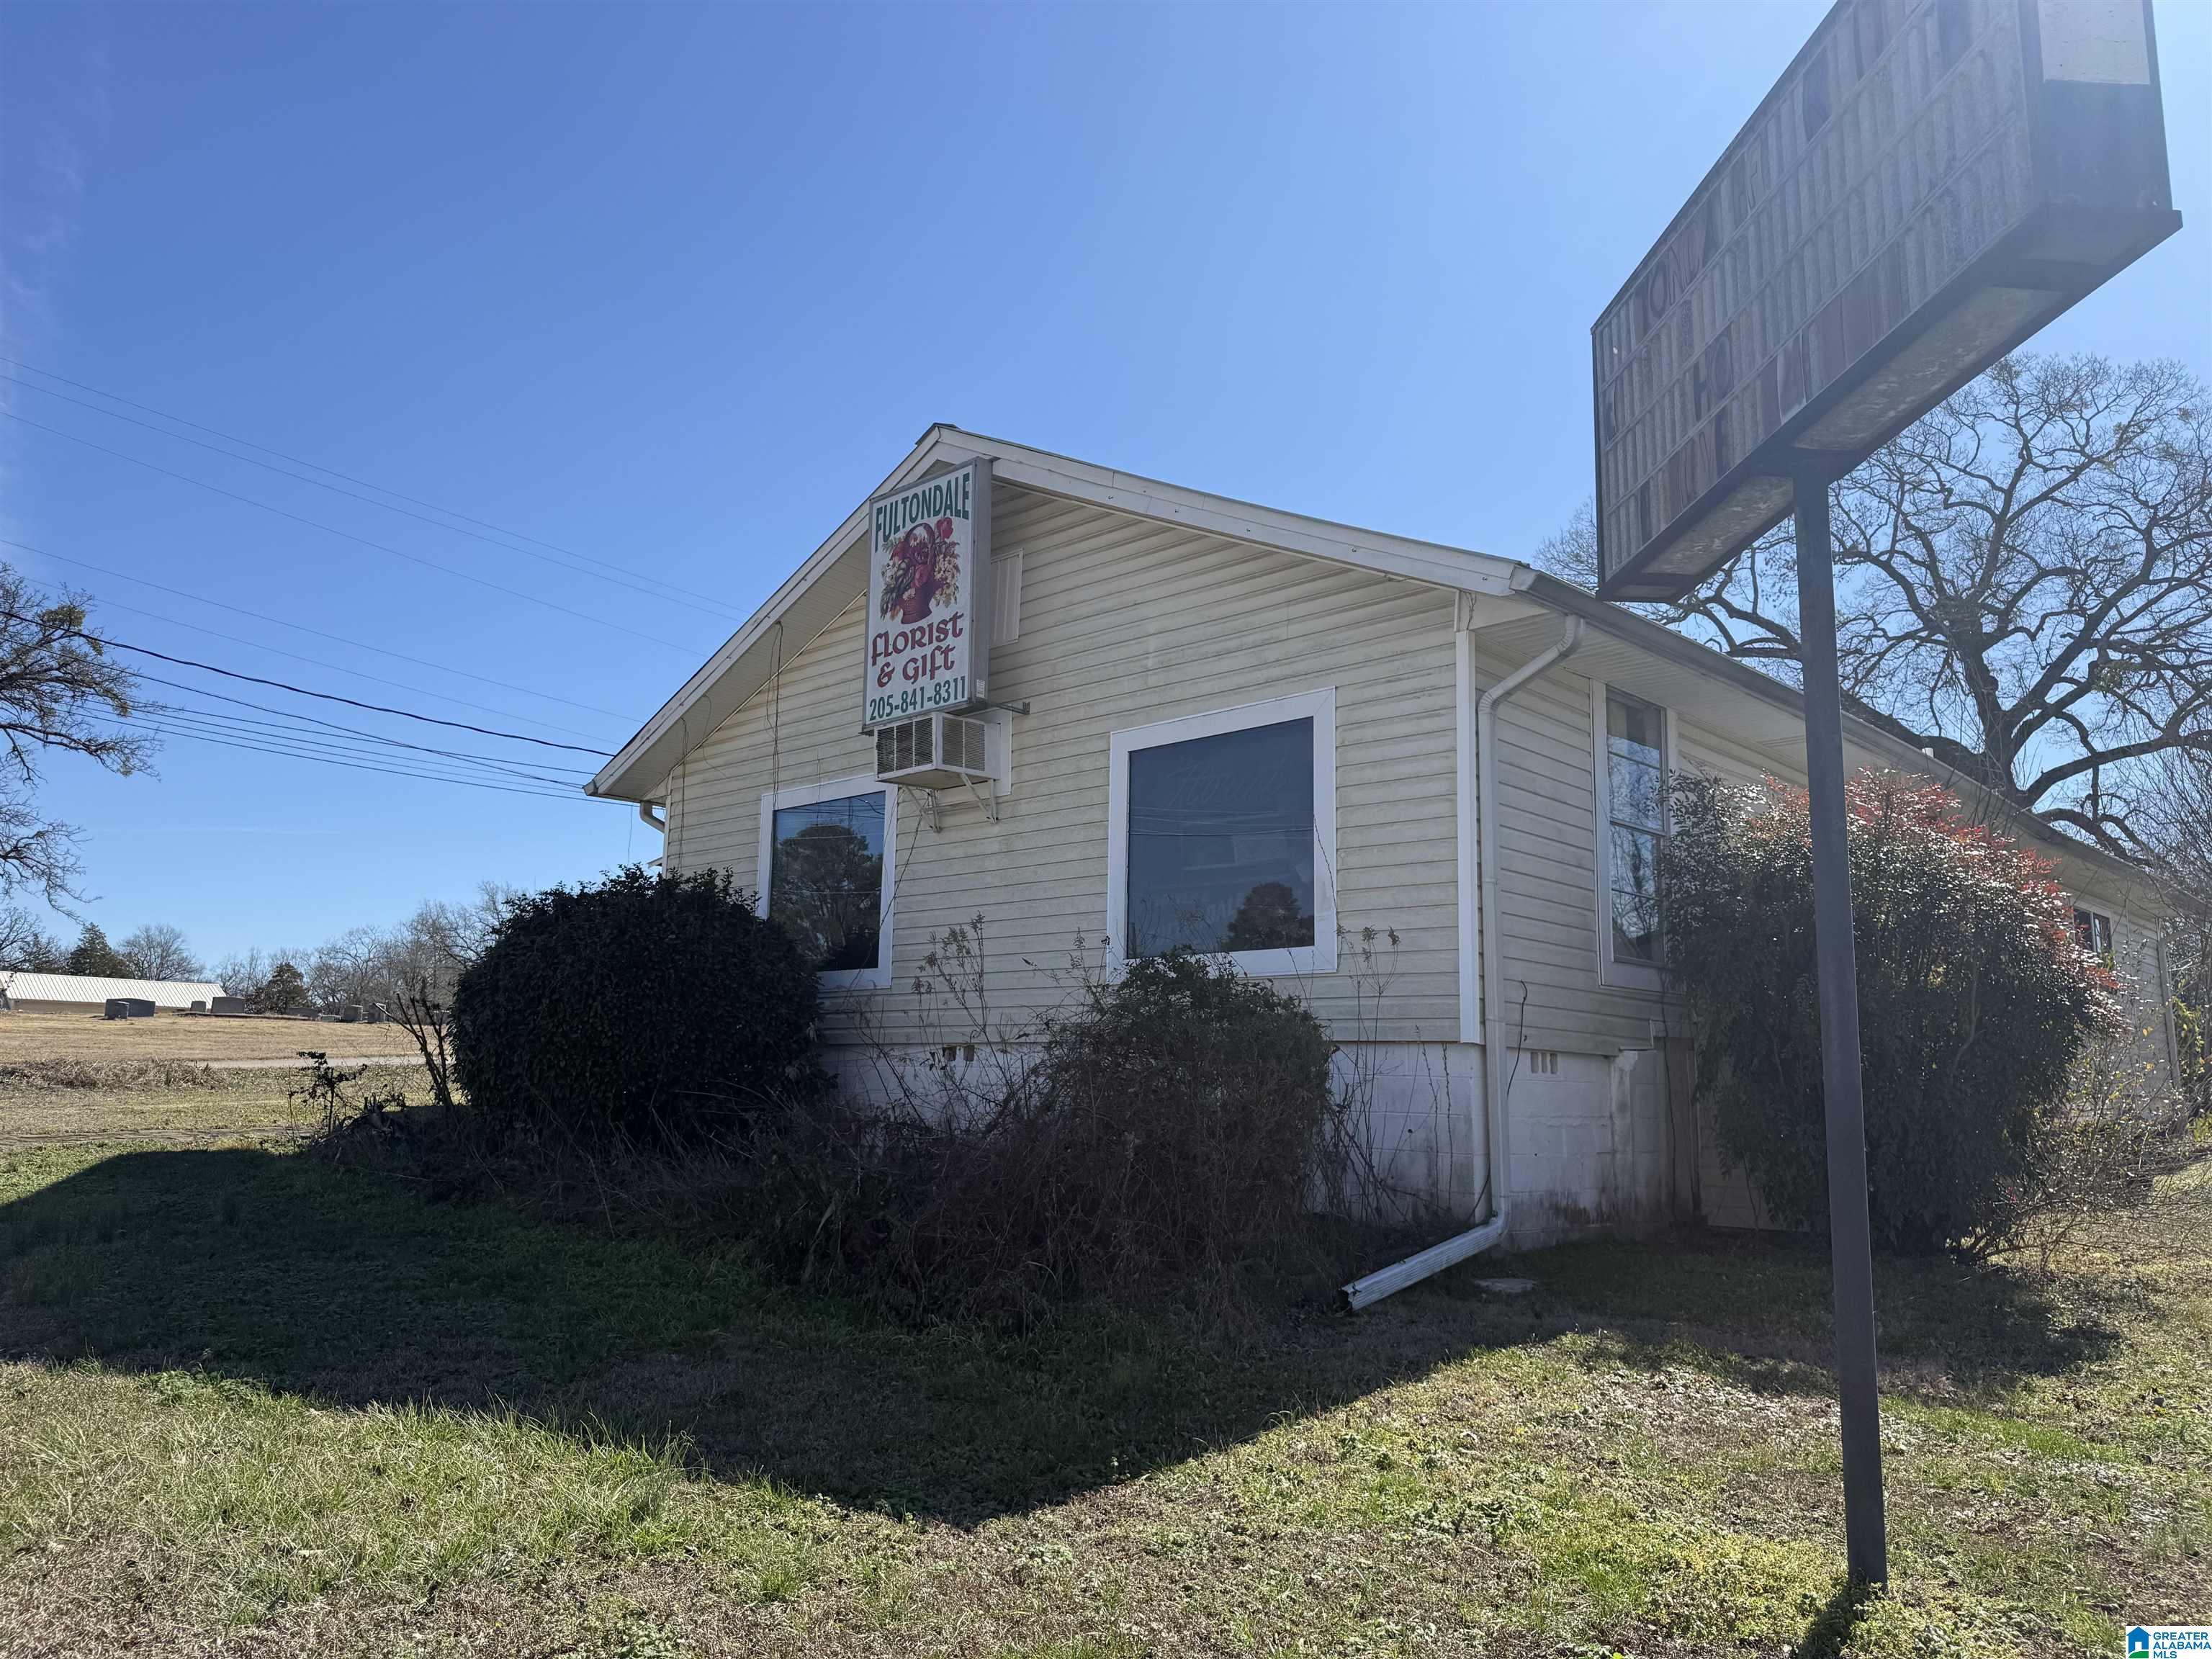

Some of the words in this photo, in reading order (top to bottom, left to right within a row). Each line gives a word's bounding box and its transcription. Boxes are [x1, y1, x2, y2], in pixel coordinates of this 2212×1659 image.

[875, 472, 970, 553] FULTONDALE
[869, 675, 966, 721] 205-841-8311
[877, 662, 895, 688] &
